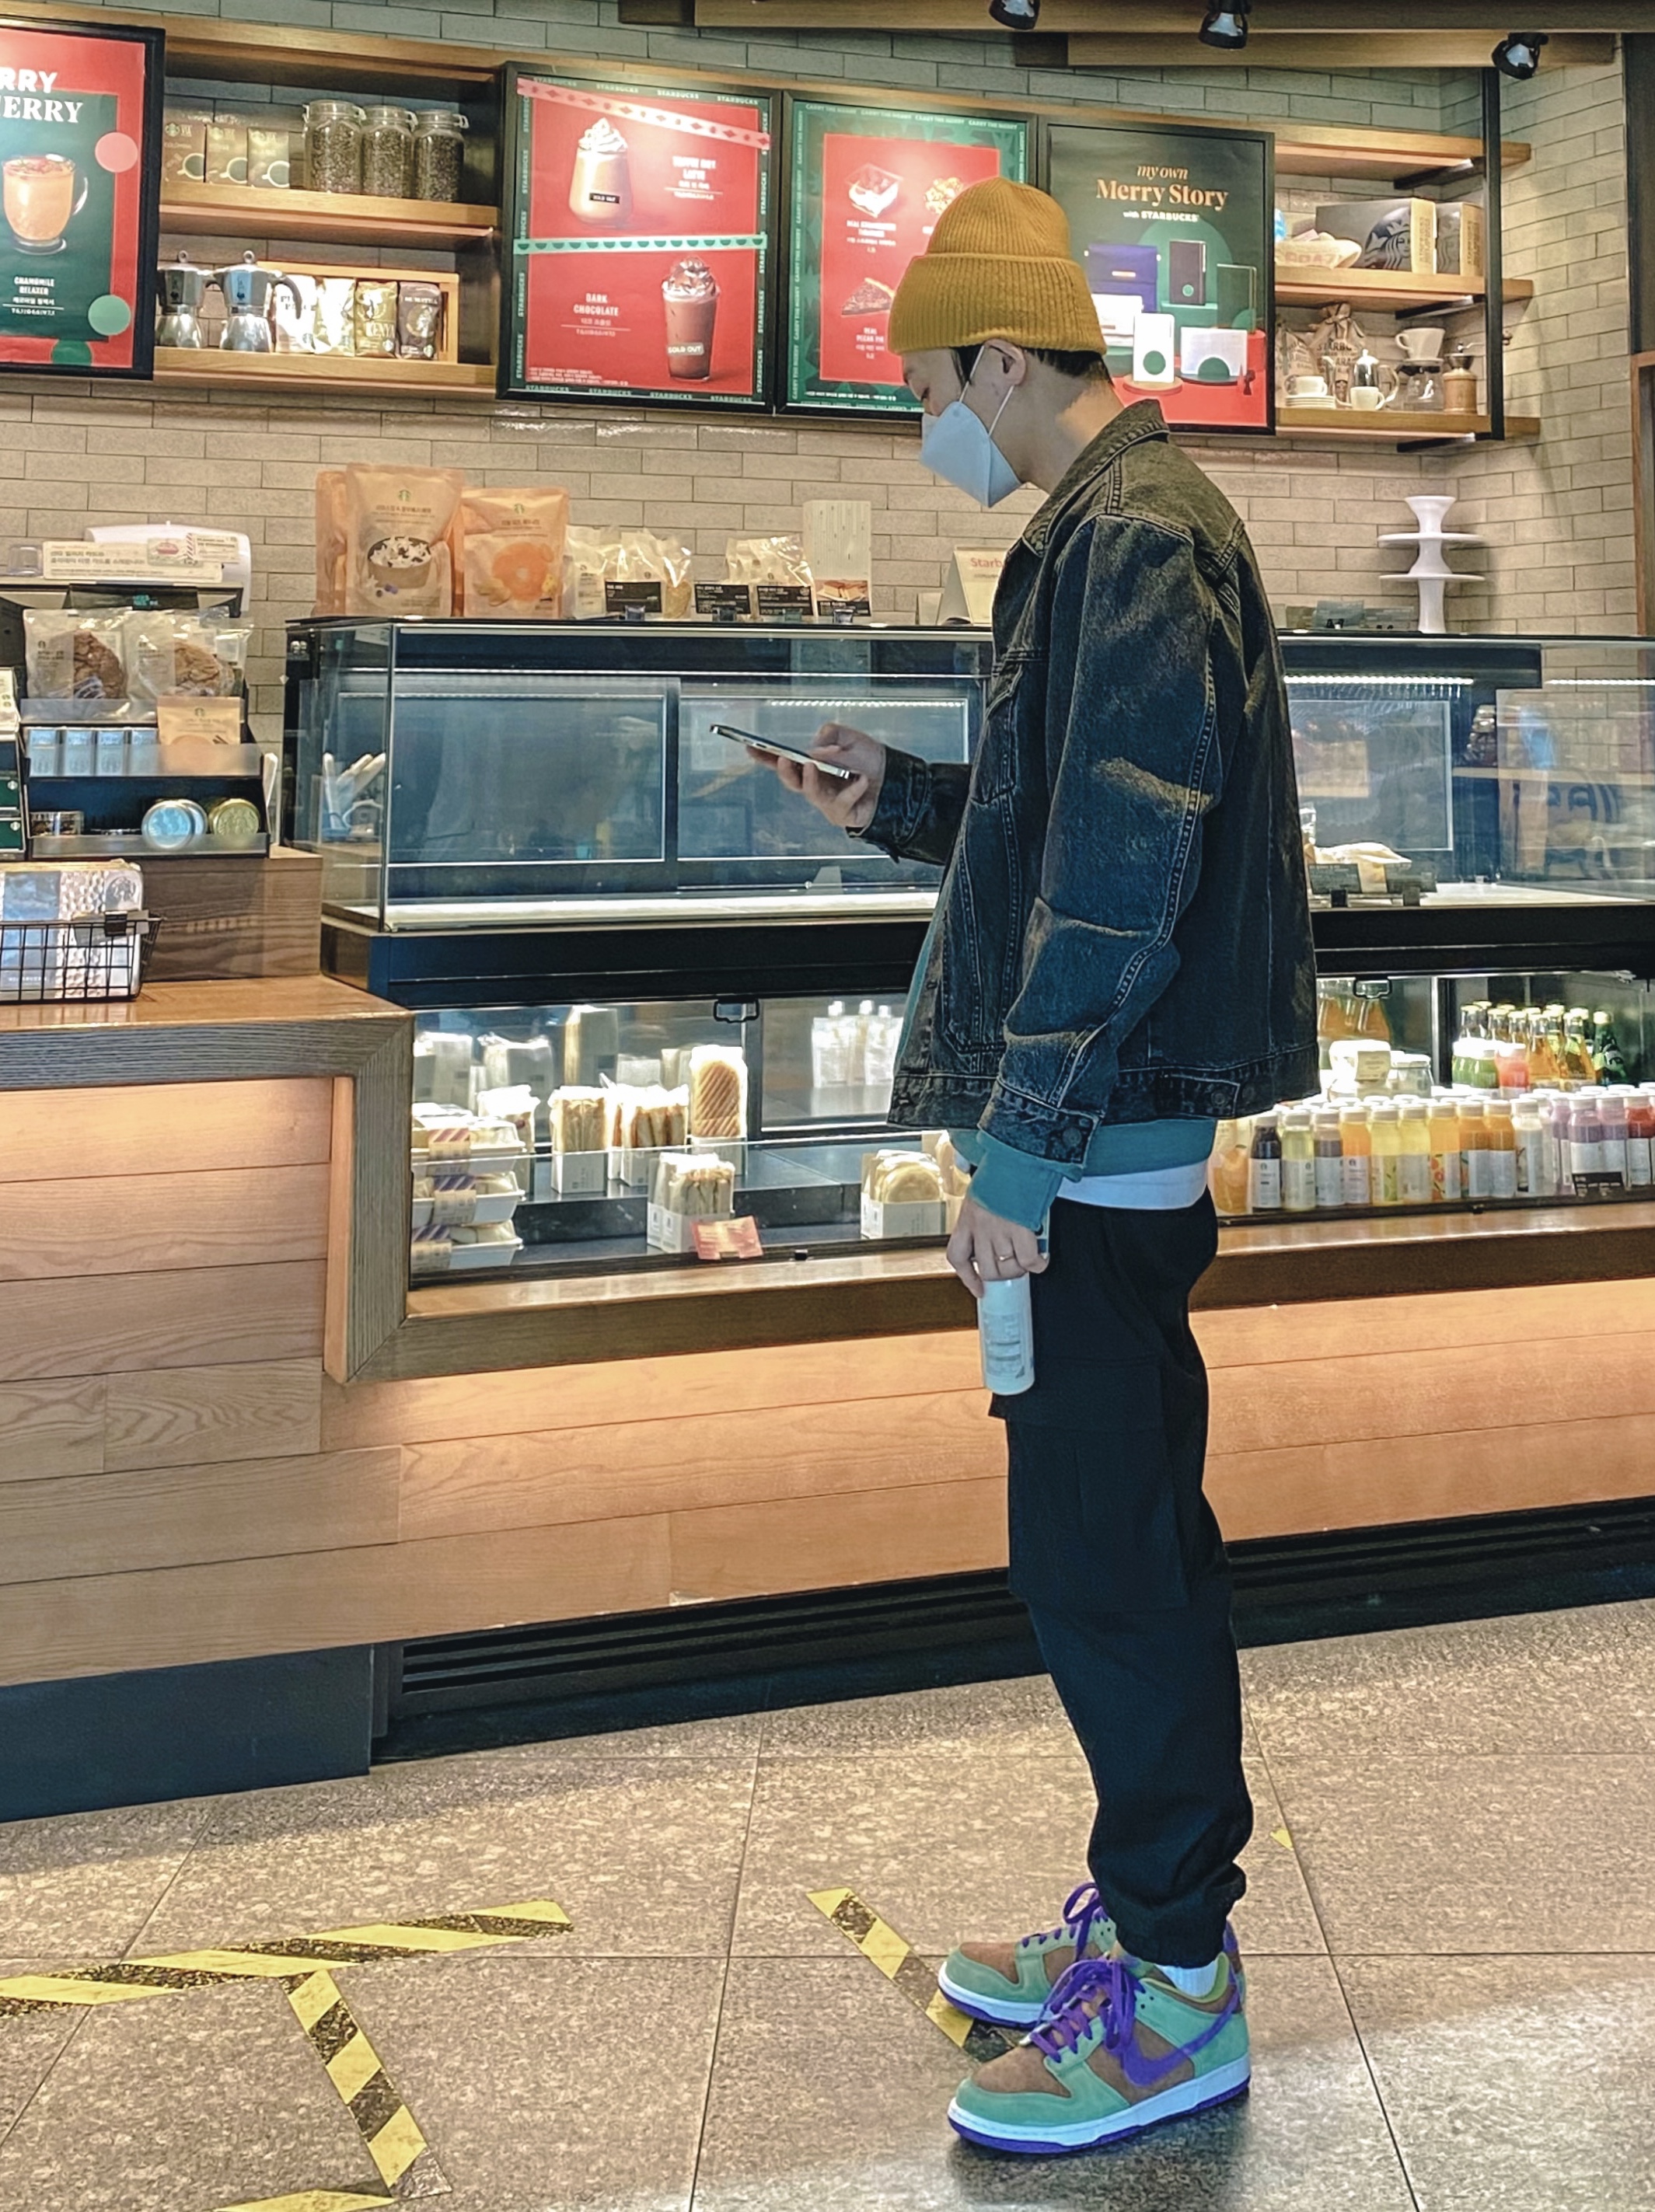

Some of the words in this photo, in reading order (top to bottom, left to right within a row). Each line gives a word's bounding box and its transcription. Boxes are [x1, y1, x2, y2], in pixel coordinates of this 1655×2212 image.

[717, 96, 759, 105] STARBUCKS
[0, 95, 83, 123] ERRY
[1137, 165, 1158, 180] my
[1159, 166, 1189, 180] own
[1096, 179, 1165, 207] Merry
[1168, 183, 1228, 211] Story
[1140, 211, 1199, 223] STARBUCKS
[585, 293, 608, 304] DARK
[573, 304, 619, 316] CHOCOLATE
[970, 556, 1004, 568] Starb
